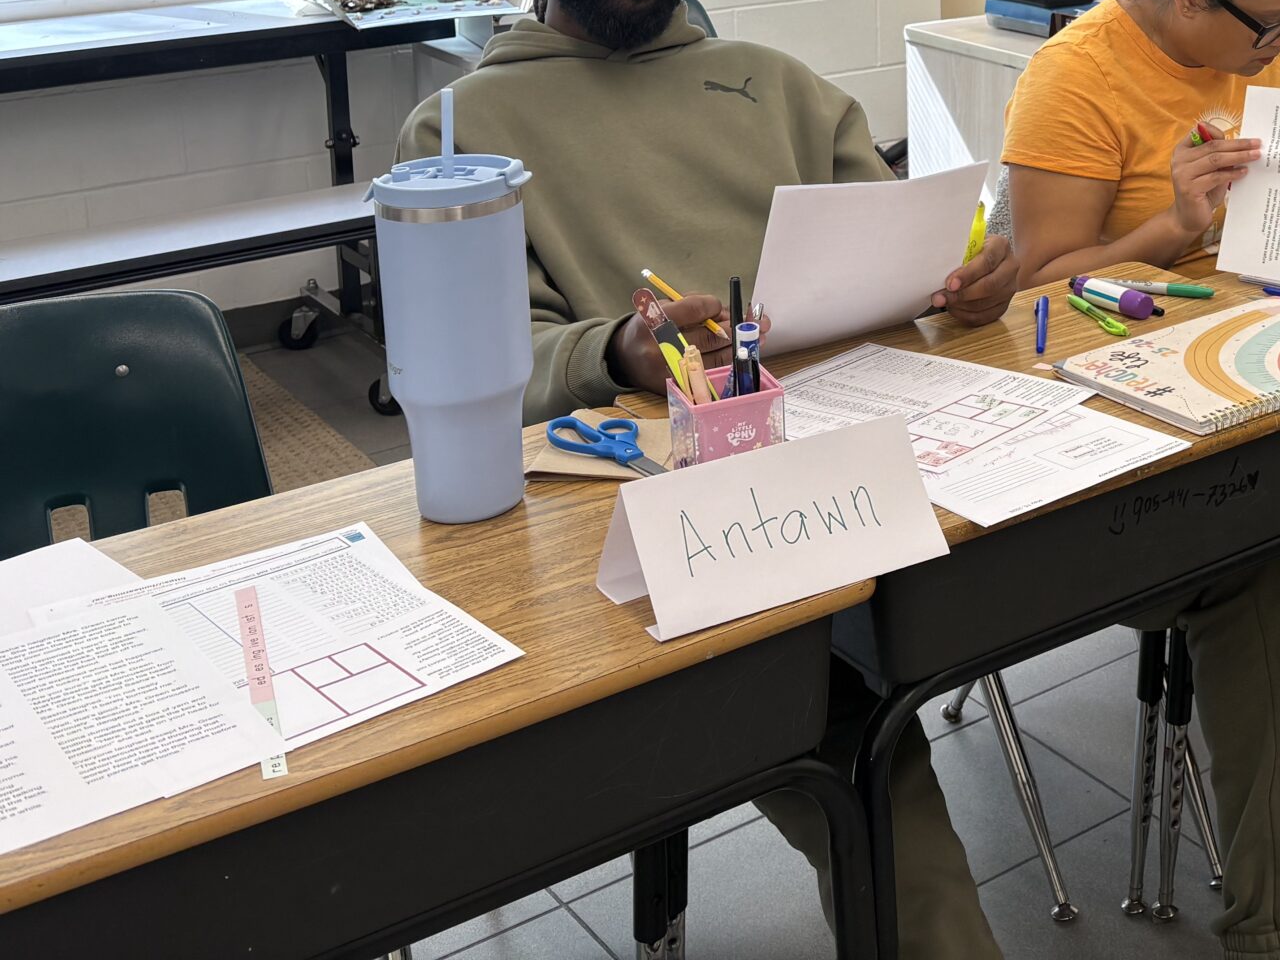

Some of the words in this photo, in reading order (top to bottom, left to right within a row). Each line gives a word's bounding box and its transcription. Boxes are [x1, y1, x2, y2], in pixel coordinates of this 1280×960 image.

[1108, 350, 1150, 369] life
[1077, 359, 1176, 397] #teacher
[726, 428, 756, 447] PONY
[731, 424, 753, 433] LITTLE
[680, 486, 881, 577] Antawn
